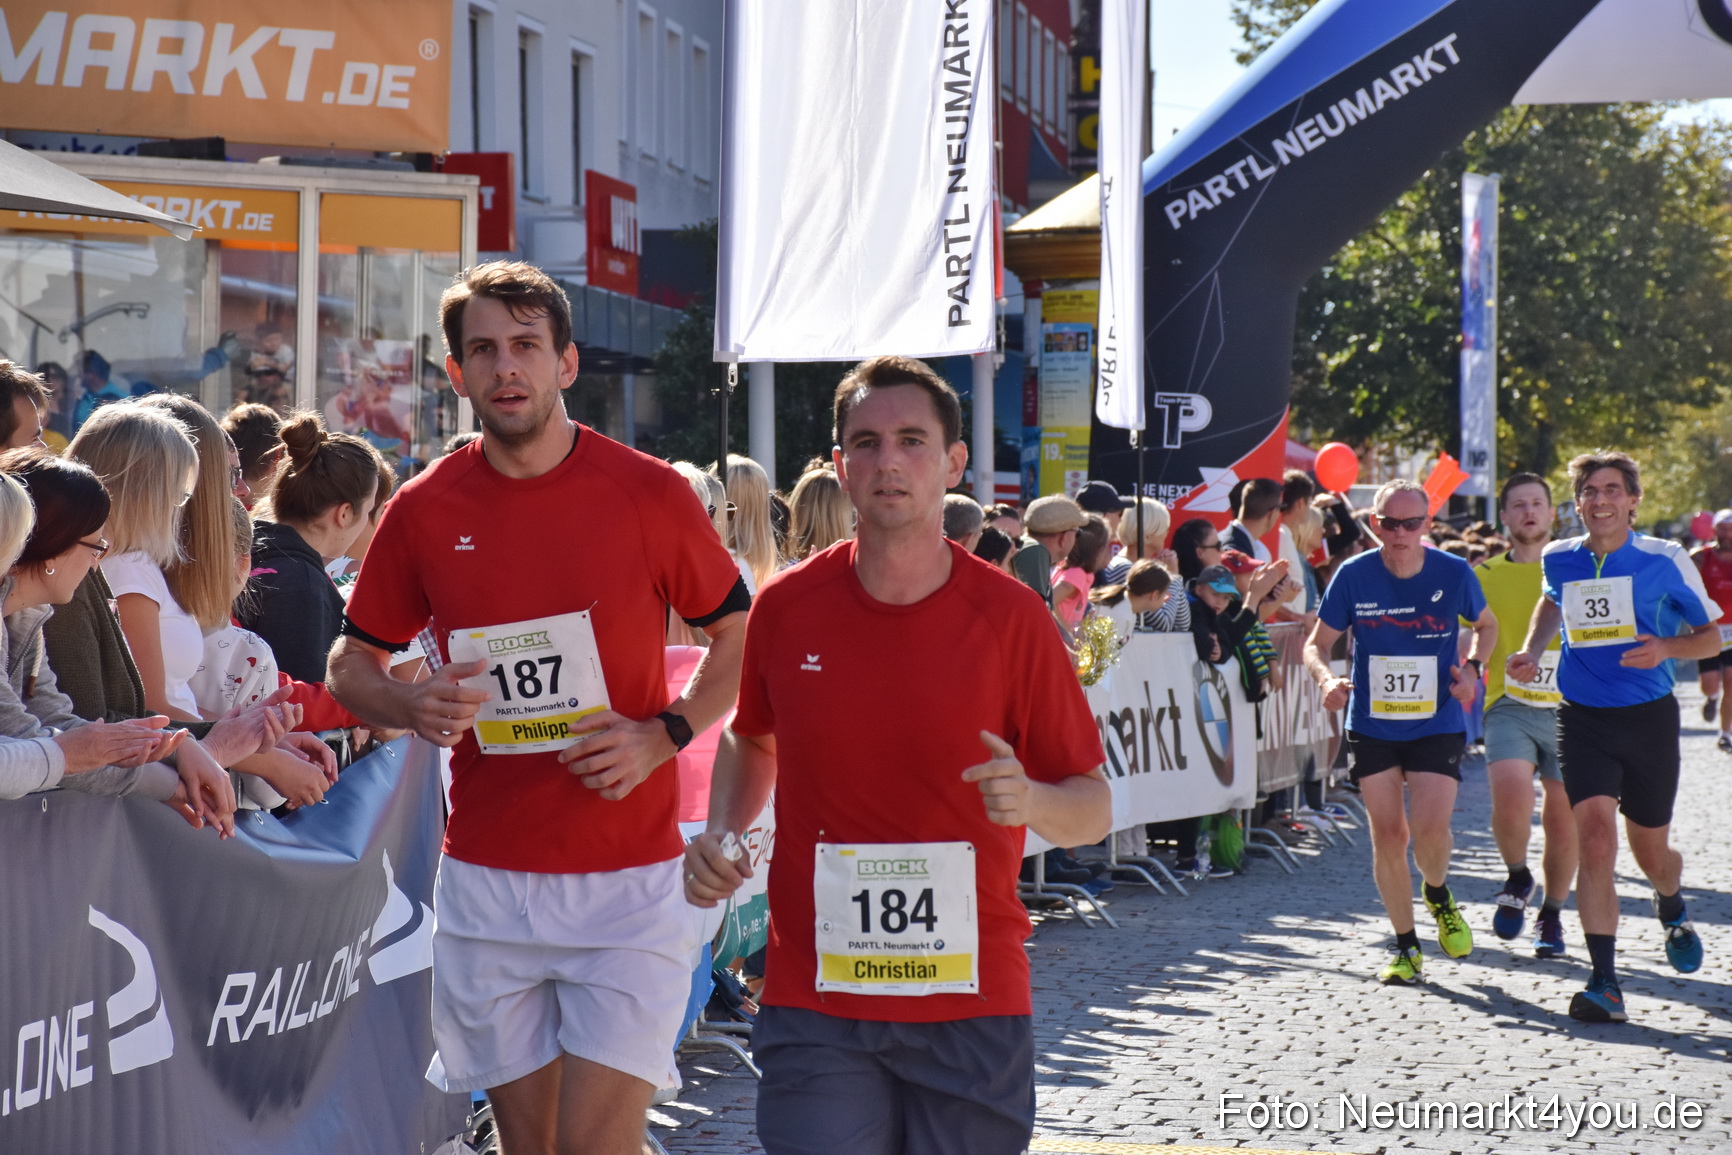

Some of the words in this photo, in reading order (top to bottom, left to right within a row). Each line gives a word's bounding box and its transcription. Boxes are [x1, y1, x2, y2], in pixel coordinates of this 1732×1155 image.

[1164, 154, 1276, 230] PARTL
[1271, 32, 1460, 166] NEUMARKT
[943, 203, 972, 328] PARTL
[1158, 484, 1193, 498] NEXT
[1585, 597, 1610, 619] 33
[487, 631, 552, 654] BOCK
[1582, 628, 1619, 640] Gottfried
[489, 655, 563, 701] 187
[1384, 673, 1420, 693] 317
[495, 706, 523, 716] PARTL
[525, 701, 566, 713] Neumarkt
[1384, 703, 1421, 712] Christian
[512, 721, 569, 740] Philipp
[857, 859, 929, 876] BOCK
[852, 888, 938, 934] 184
[848, 941, 882, 950] PARTL
[883, 941, 930, 951] Neumarkt
[854, 960, 937, 979] Christian
